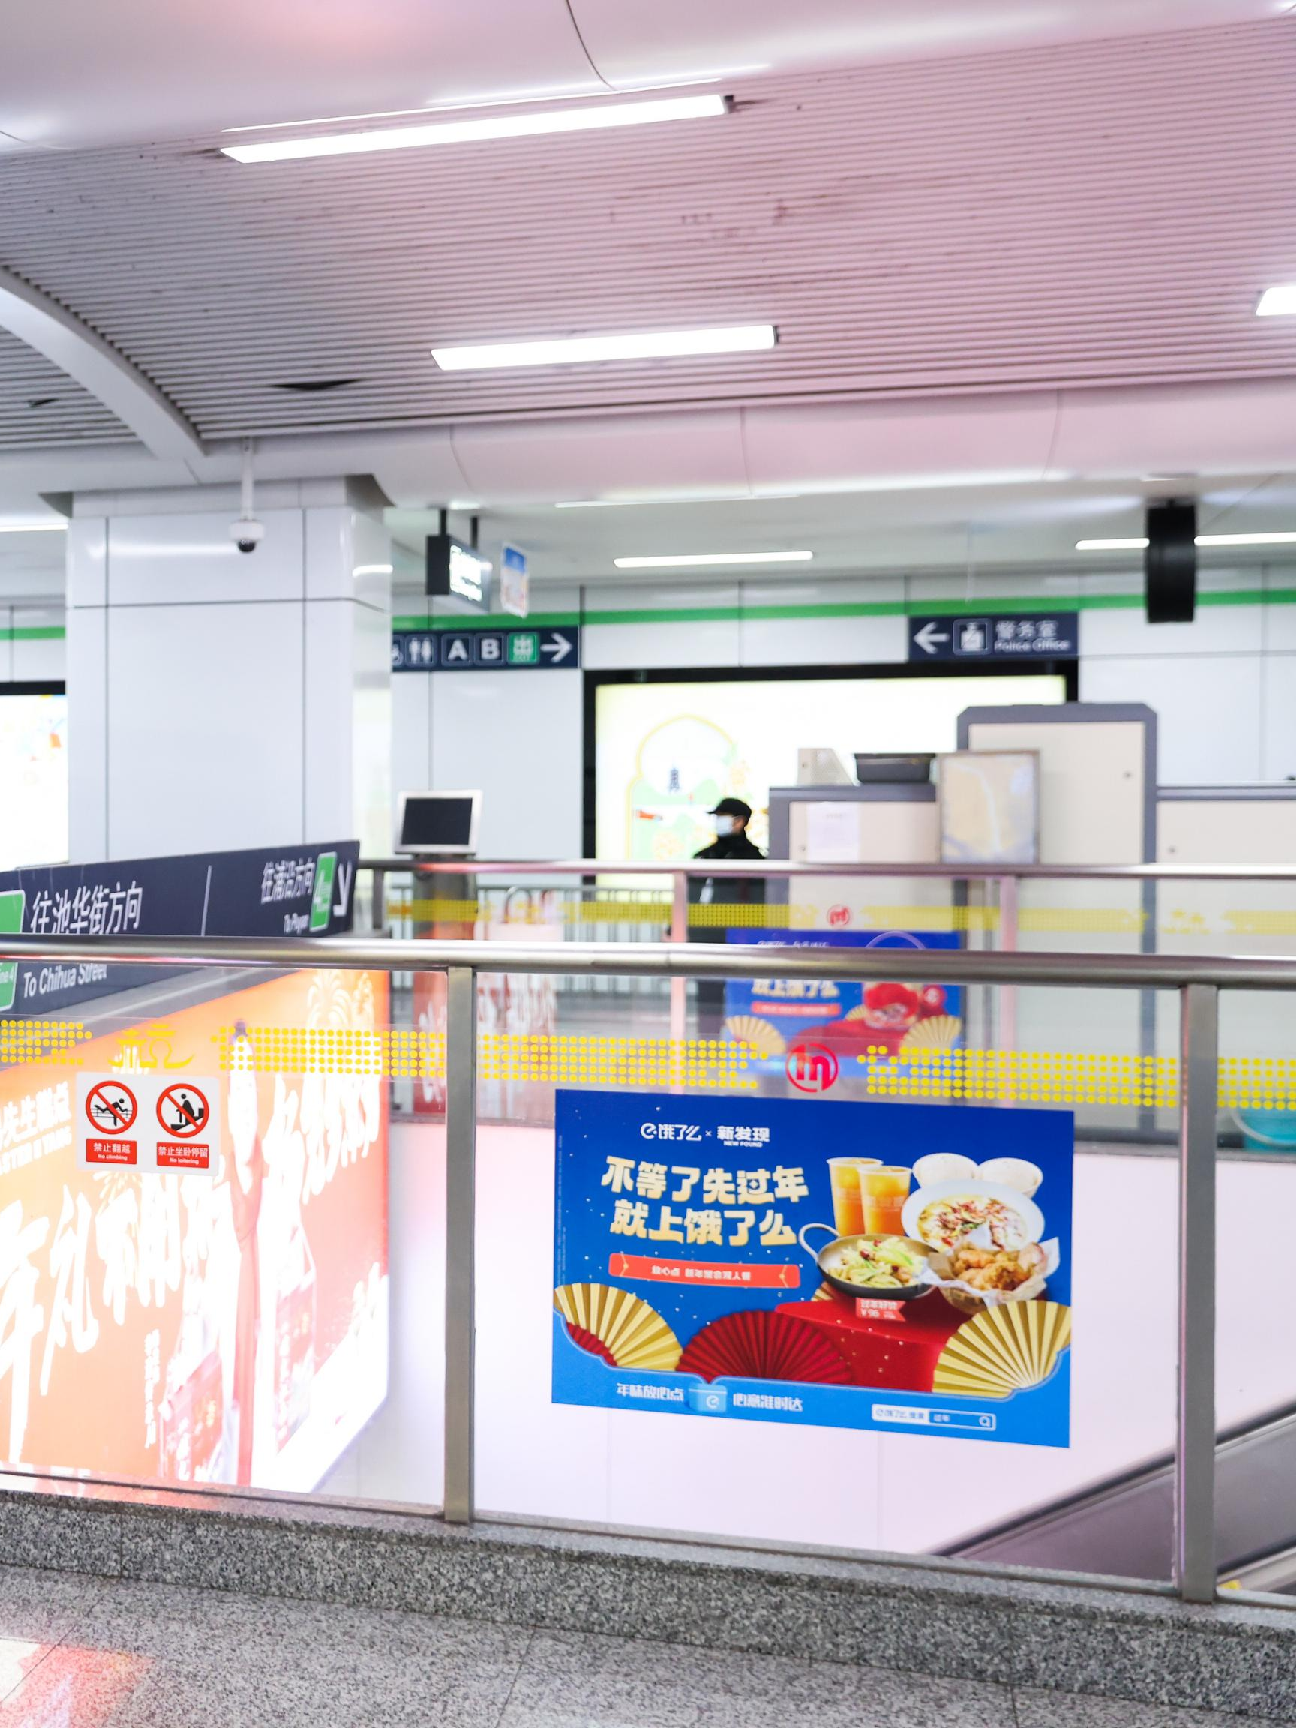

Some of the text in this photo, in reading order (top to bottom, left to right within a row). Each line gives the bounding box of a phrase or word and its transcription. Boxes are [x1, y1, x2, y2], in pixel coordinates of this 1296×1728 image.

[448, 640, 468, 661] A
[480, 638, 499, 660] B
[31, 880, 143, 935] 往池华街方向
[23, 971, 37, 998] To
[39, 964, 77, 995] Chihua
[658, 1123, 702, 1141] 饿了么
[716, 1125, 771, 1142] 新发现
[93, 1142, 131, 1154] 禁止翻越
[601, 1155, 809, 1205] 不等了先过年
[610, 1199, 798, 1246] 就上饿了么
[616, 1382, 684, 1402] 年味放心点
